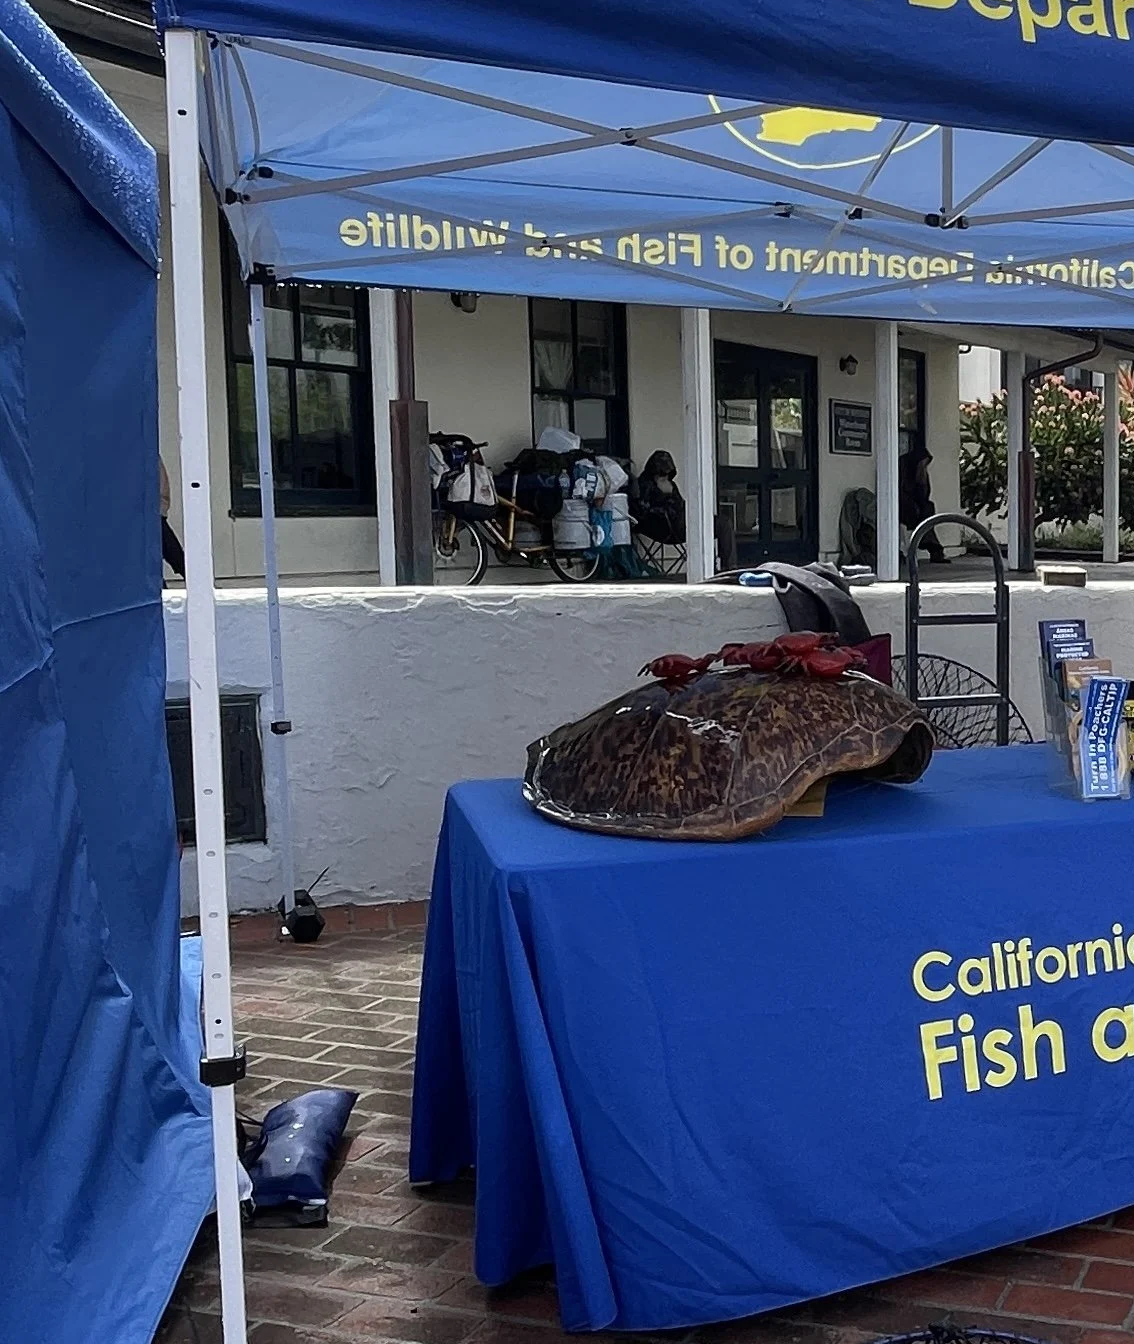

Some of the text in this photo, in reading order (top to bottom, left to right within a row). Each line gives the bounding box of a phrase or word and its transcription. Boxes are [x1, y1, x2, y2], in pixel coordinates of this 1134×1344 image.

[1088, 682, 1108, 792] Turn In Poachers
[918, 1004, 1067, 1100] Fish
